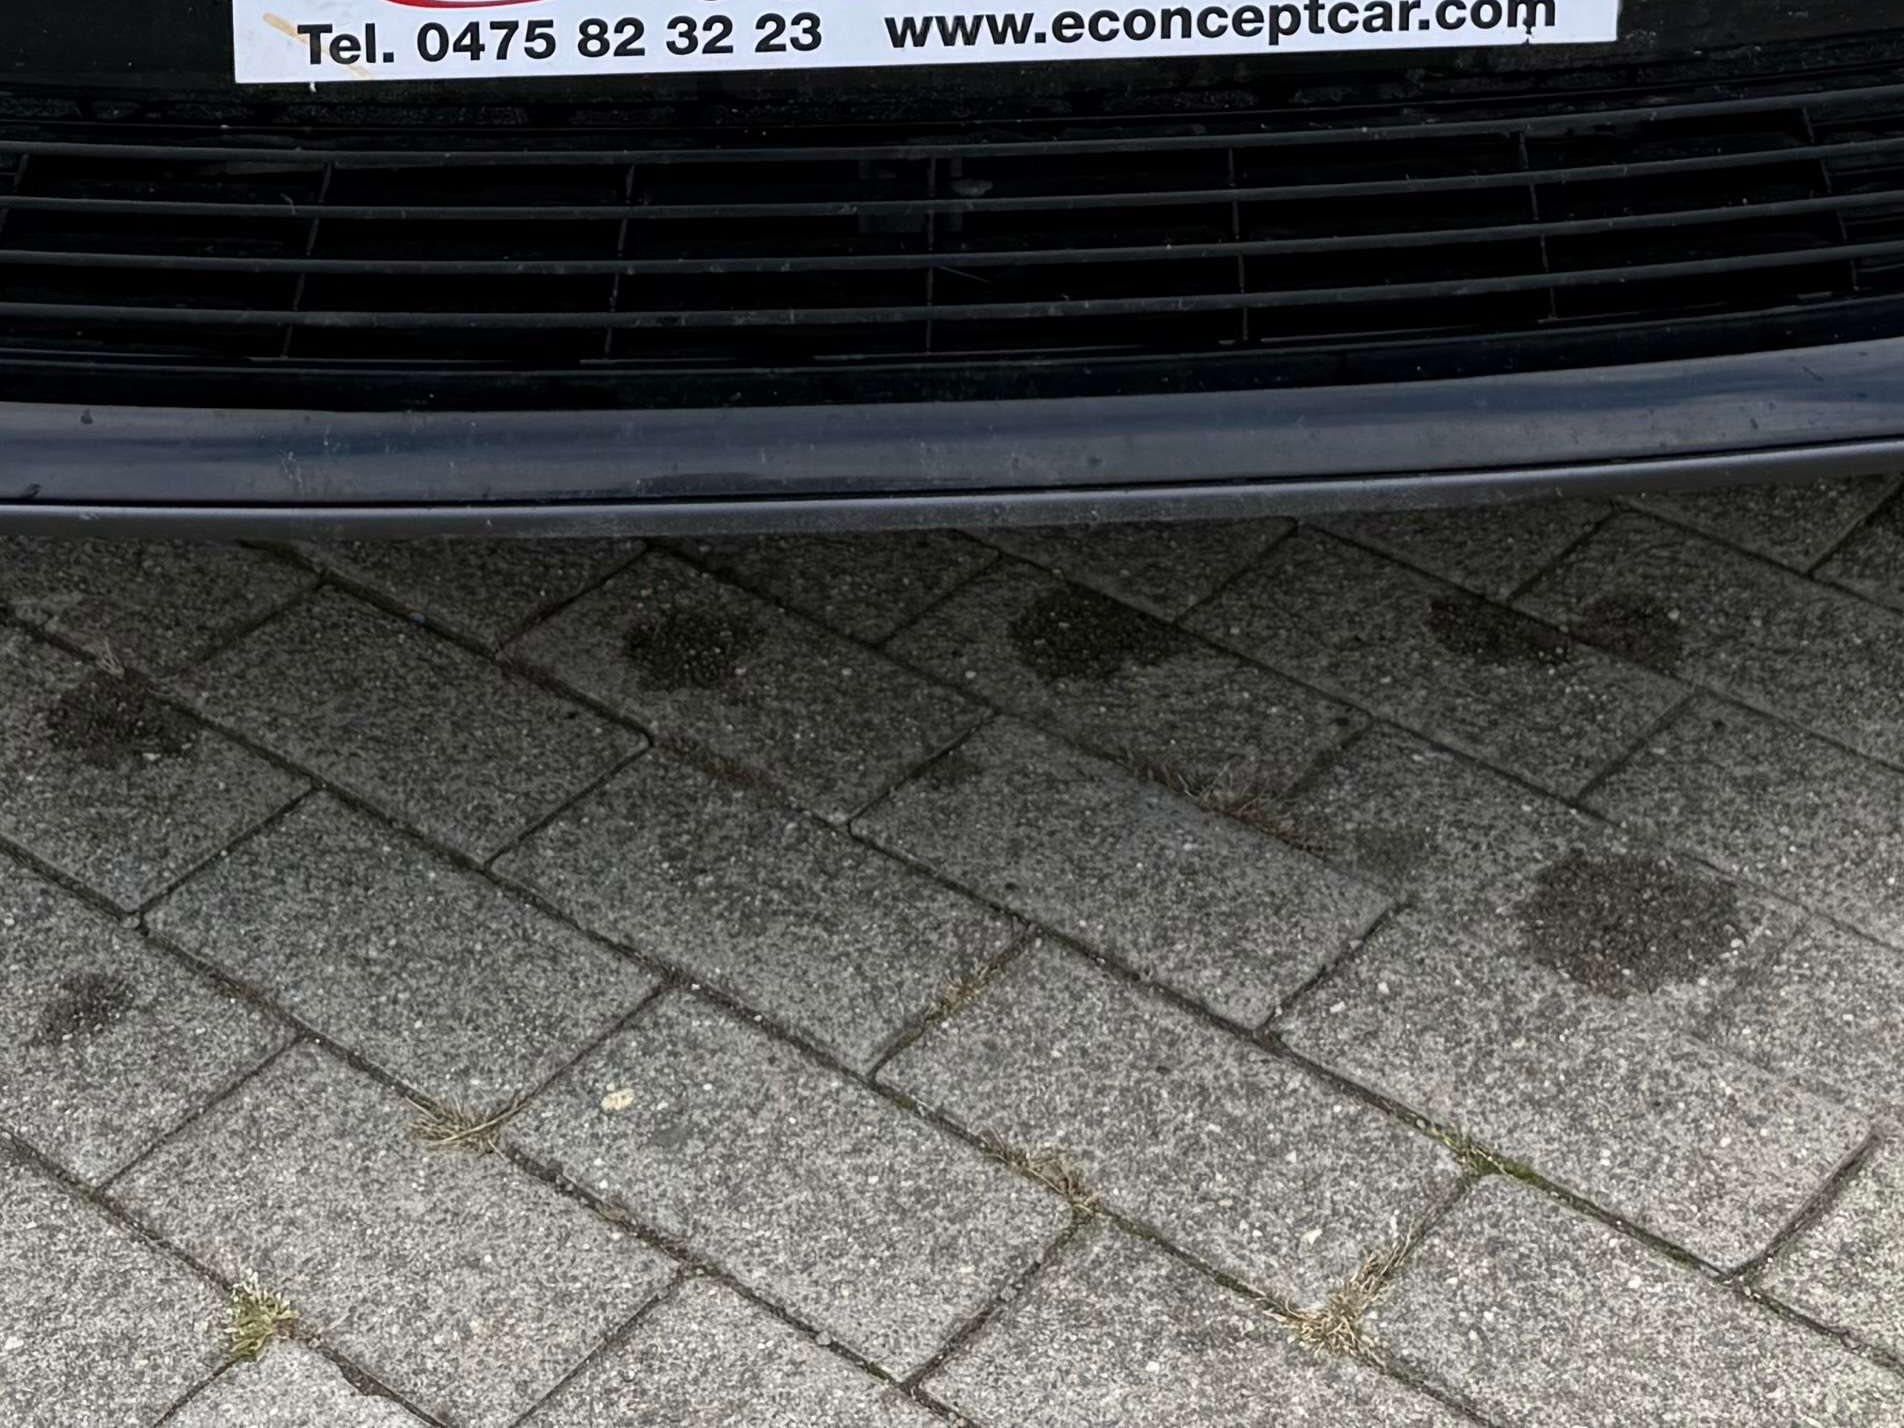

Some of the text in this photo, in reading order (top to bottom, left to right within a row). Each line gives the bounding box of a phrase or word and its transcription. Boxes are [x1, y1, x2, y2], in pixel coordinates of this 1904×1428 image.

[298, 22, 395, 65] Tel.
[416, 18, 556, 62] 0475
[576, 16, 645, 59] 82
[666, 13, 734, 56] 32
[754, 11, 823, 53] 23
